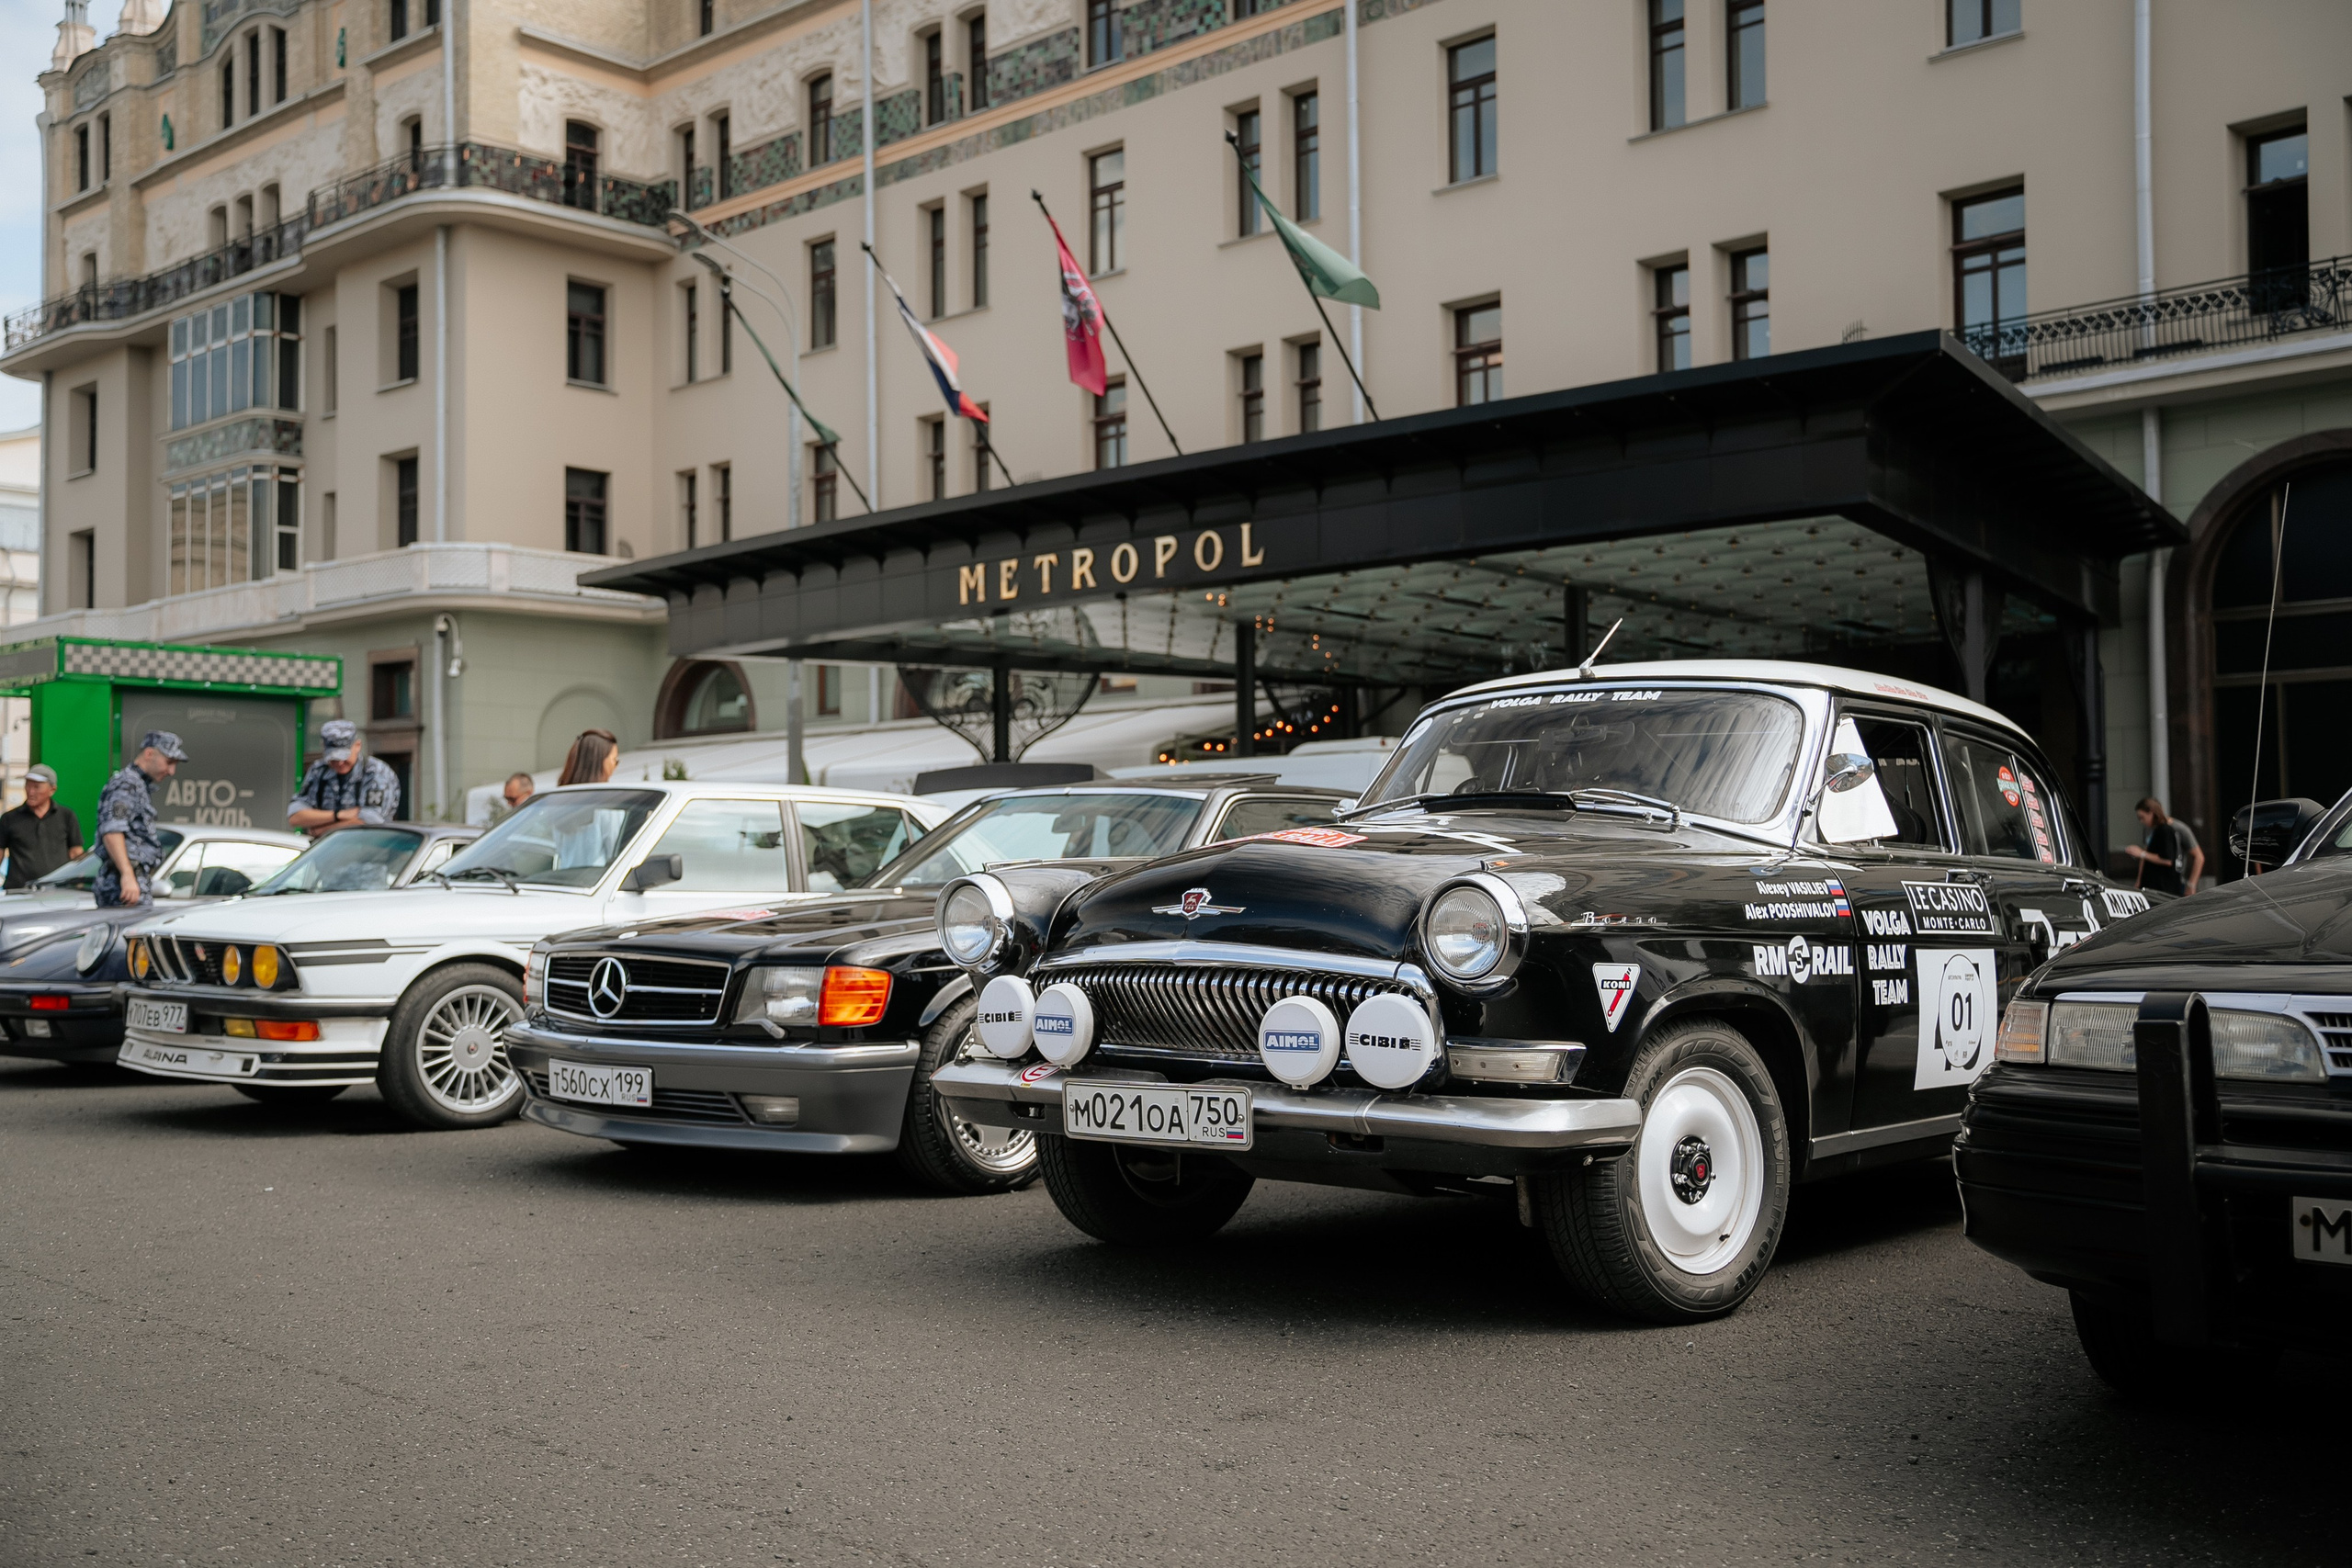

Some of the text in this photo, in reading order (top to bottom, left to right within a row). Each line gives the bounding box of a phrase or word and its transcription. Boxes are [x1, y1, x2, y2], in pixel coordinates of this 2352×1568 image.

[959, 522, 1264, 606] METROPOL
[1490, 690, 1663, 709] VOLGA RALLY TEAM
[1755, 880, 1829, 898] Alexey VASILIEV
[1908, 886, 1984, 913] LE CASINO
[2107, 893, 2147, 915] MILAN
[1745, 902, 1838, 920] Alex PODSHIVALOV
[1861, 910, 1912, 935] VOLGA
[1812, 945, 1853, 975] RAIL
[1867, 944, 1906, 970] RALLY
[1602, 980, 1631, 989] KONI
[1872, 979, 1908, 1005] TEAM
[163, 1005, 182, 1021] 977
[1951, 992, 1972, 1031] 01
[1035, 1018, 1072, 1032] AIMOL
[1266, 1034, 1318, 1049] AIMOL
[142, 1049, 187, 1065] ALPINA
[615, 1071, 643, 1093] 199
[621, 1093, 636, 1101] RUS
[1190, 1095, 1238, 1126] 750
[1202, 1126, 1226, 1138] RUS
